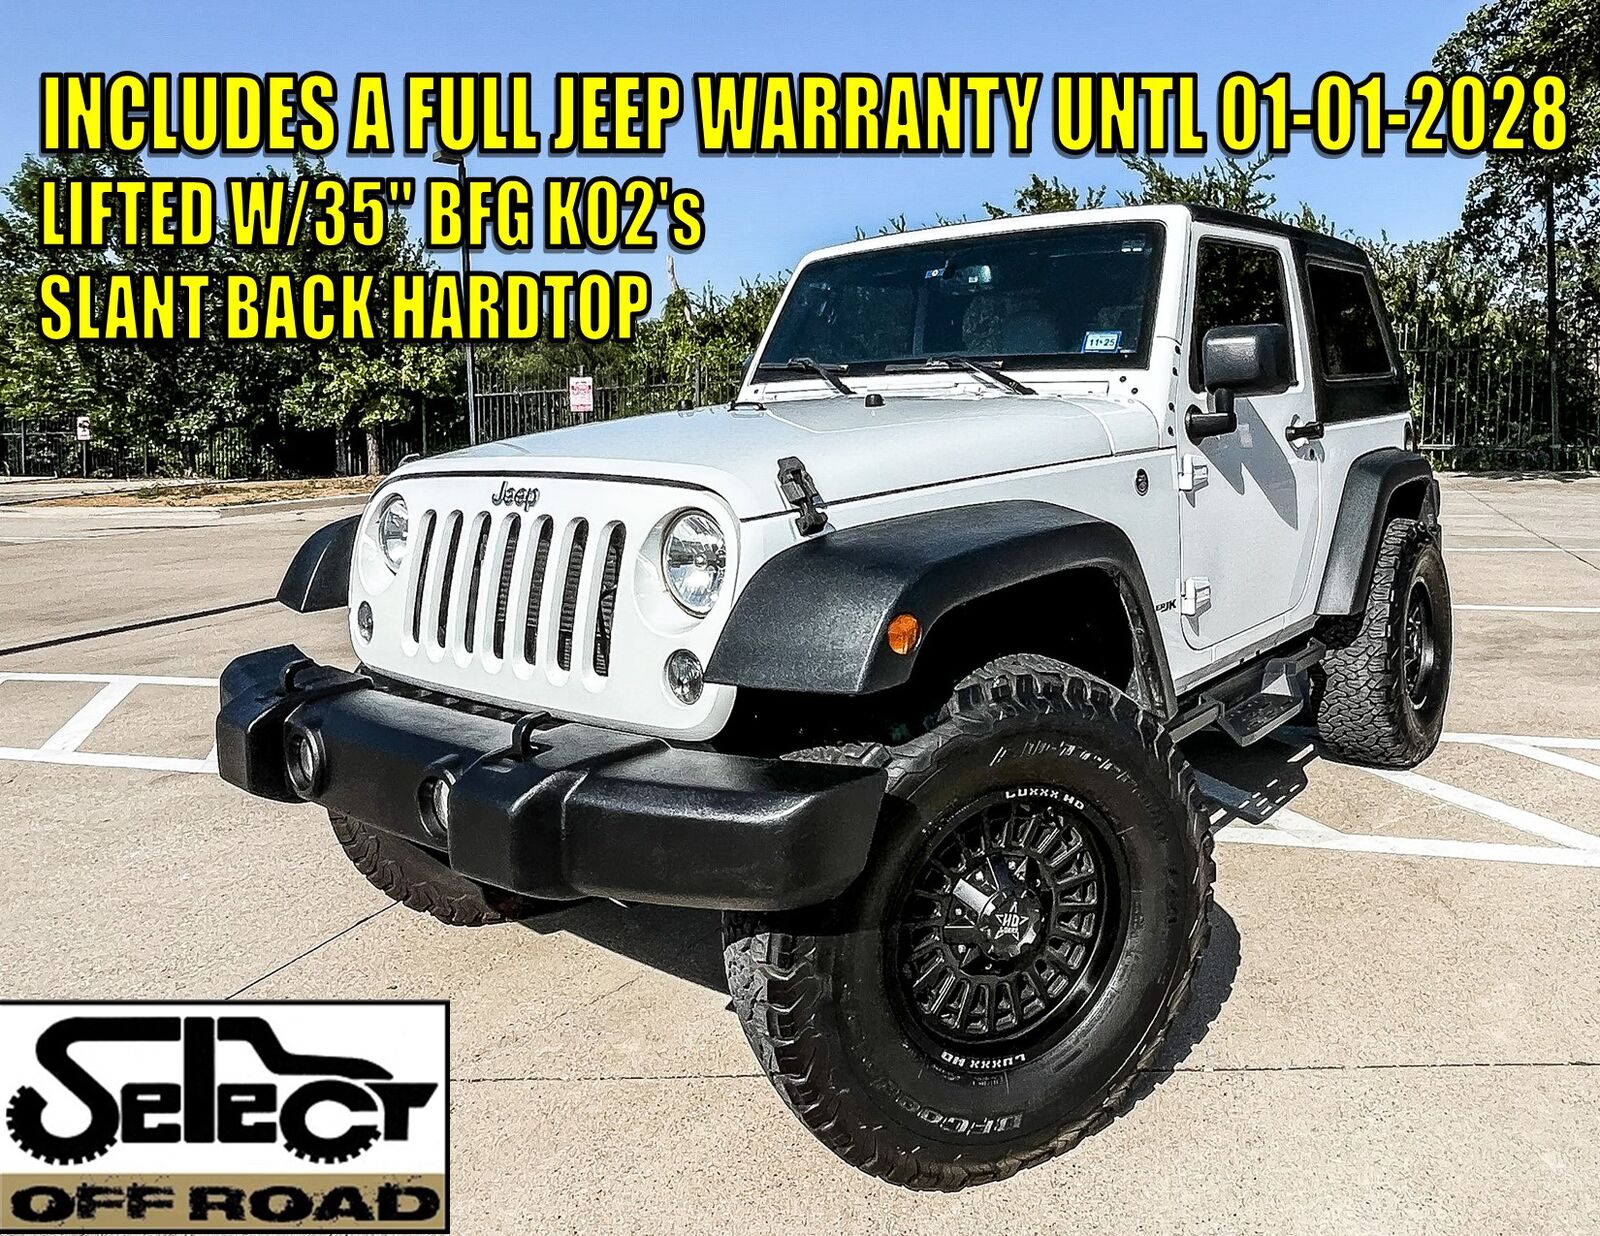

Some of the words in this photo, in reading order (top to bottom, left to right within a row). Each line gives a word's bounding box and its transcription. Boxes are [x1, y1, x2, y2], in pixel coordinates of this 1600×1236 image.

[491, 480, 541, 513] Jeep
[1004, 787, 1060, 800] LUXXX
[1062, 793, 1086, 811] HD
[940, 1050, 967, 1068] HD
[969, 1052, 1027, 1070] LUXXX
